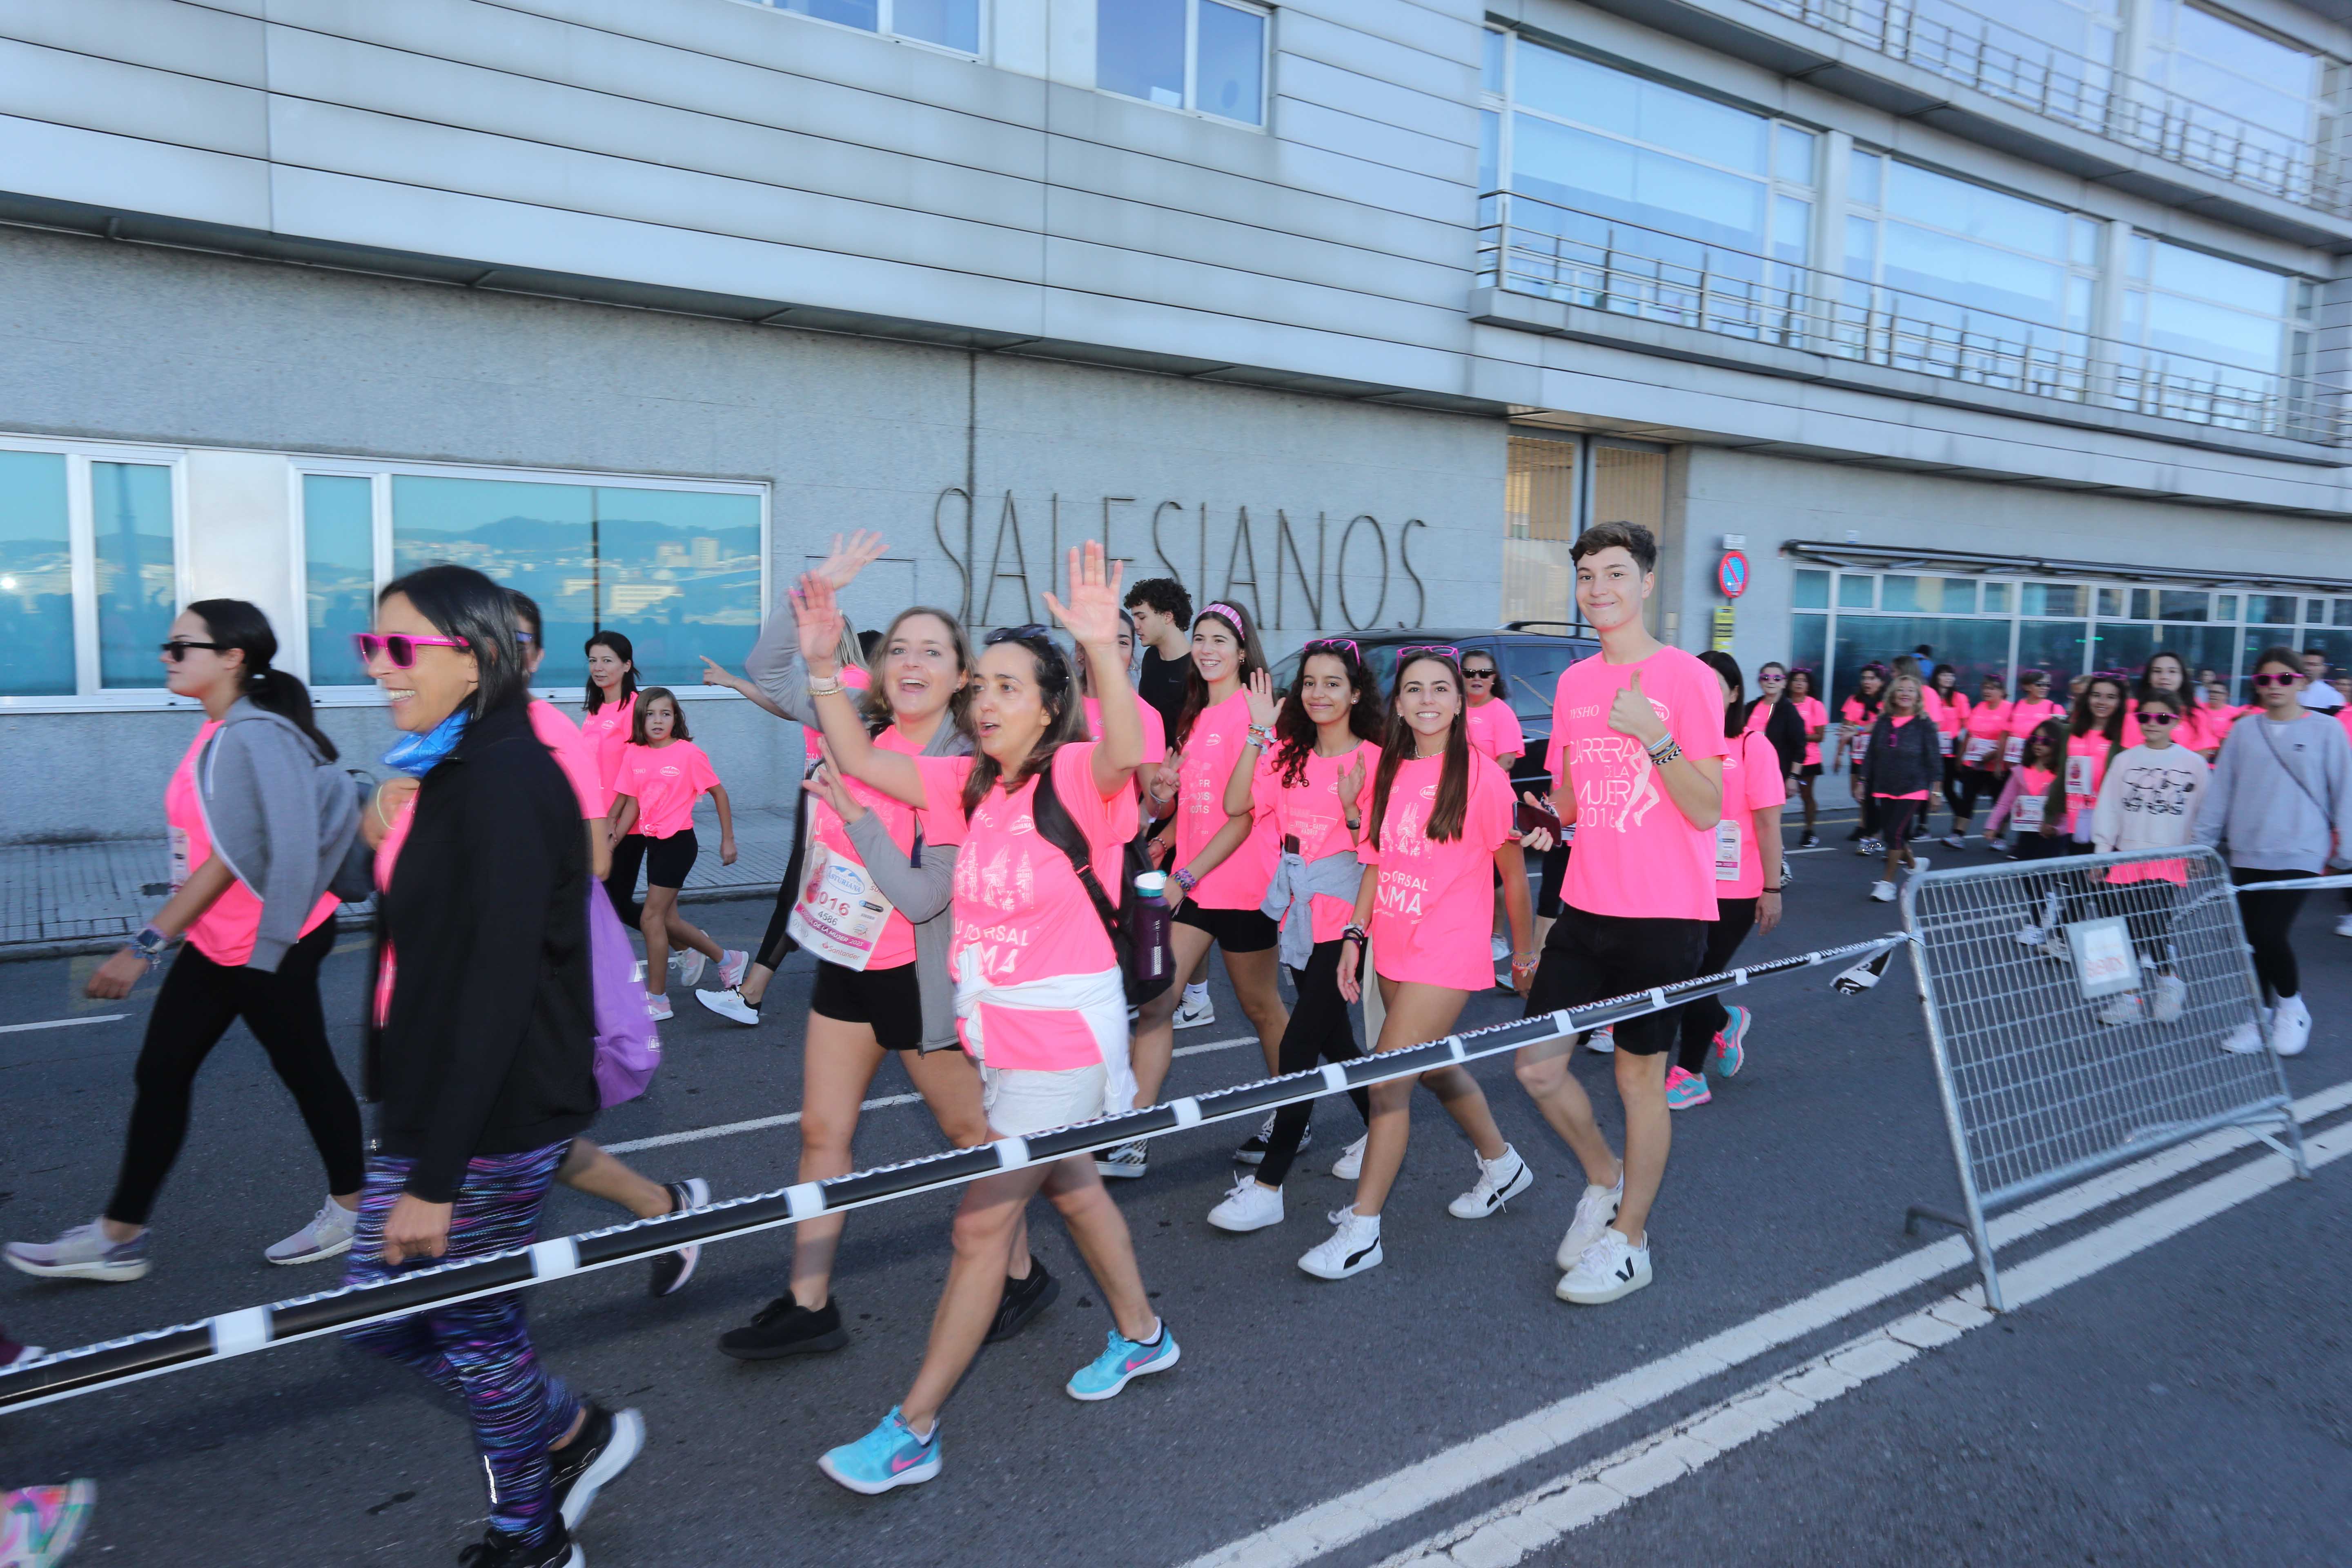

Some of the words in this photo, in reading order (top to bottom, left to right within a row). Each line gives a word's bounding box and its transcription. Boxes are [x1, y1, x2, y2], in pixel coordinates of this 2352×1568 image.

[935, 487, 1425, 631] SALESIANOS
[1382, 871, 1428, 891] DORSAL
[1378, 885, 1422, 916] UMA
[818, 910, 838, 926] 4586
[821, 925, 829, 933] LA
[829, 930, 849, 943] MUJER
[849, 939, 864, 947] 2023
[828, 945, 861, 960] Santander
